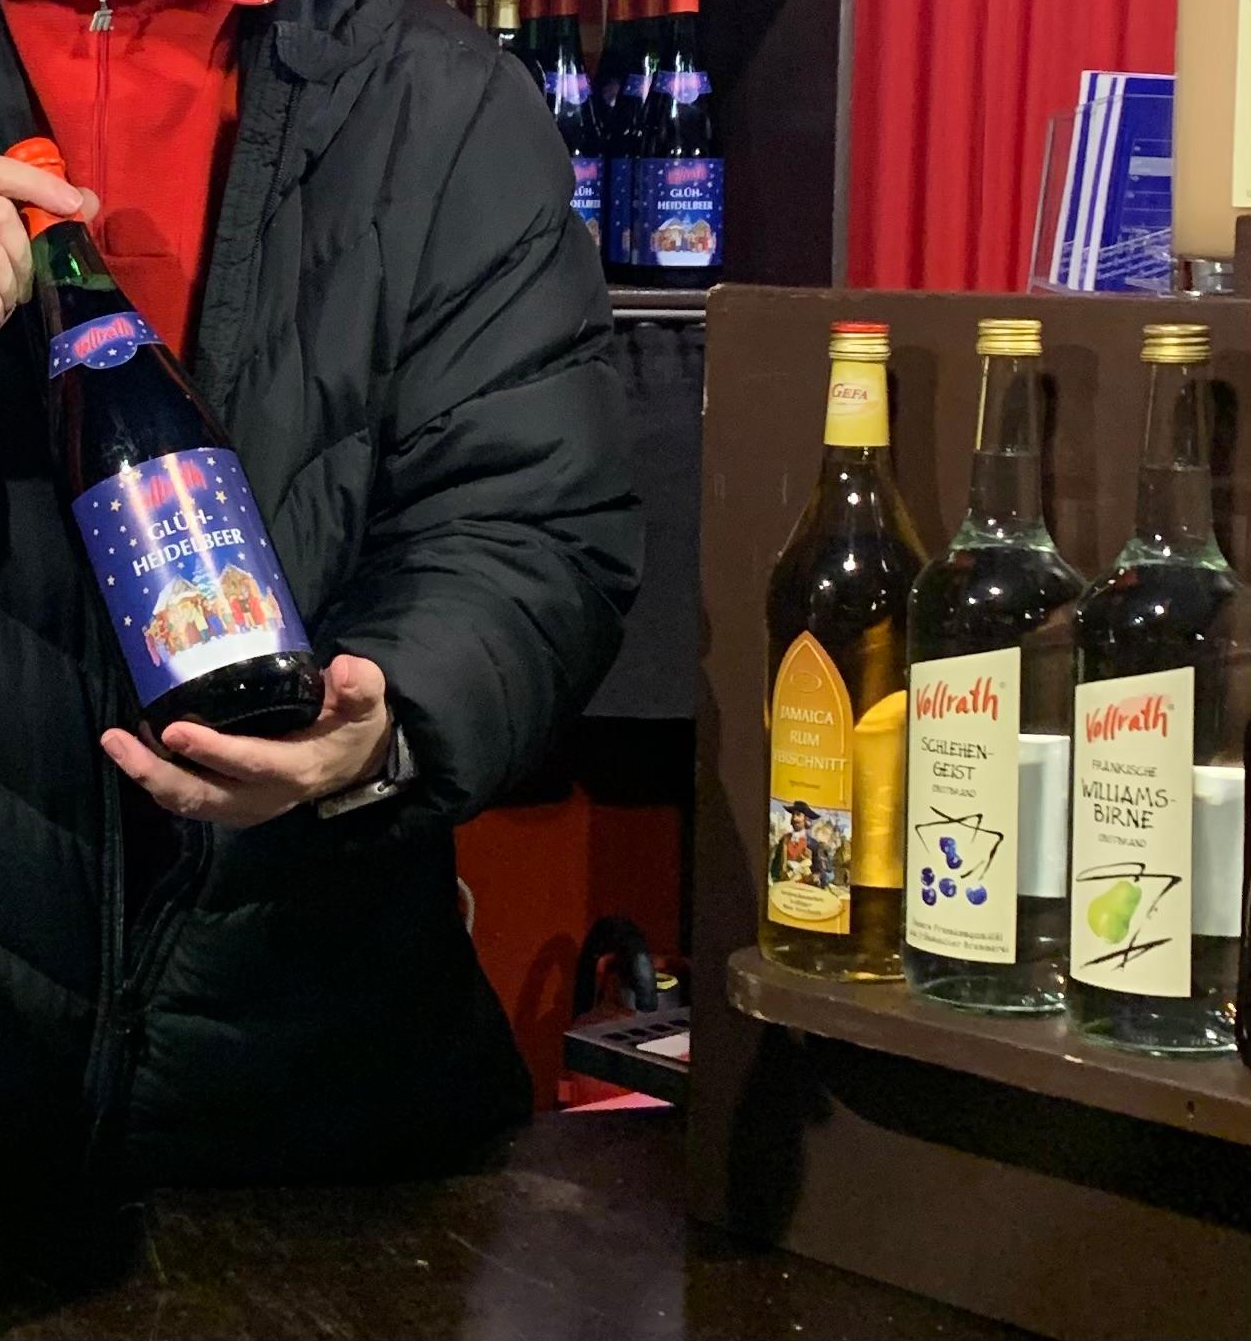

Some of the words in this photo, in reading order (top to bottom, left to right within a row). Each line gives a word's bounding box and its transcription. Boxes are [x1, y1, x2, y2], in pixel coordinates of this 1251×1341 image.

[669, 186, 703, 198] GLÜH-
[657, 200, 714, 210] HEIDELBEER
[132, 528, 245, 577] HEIDELBEER
[916, 677, 999, 721] Vollrath
[780, 705, 834, 725] JAMAICA
[1085, 695, 1168, 743] Vollrath
[790, 729, 820, 747] RUM
[921, 736, 995, 759] SCHLEHEN-
[933, 761, 976, 780] GEIST
[1081, 778, 1177, 809] WILLIAMS-
[1093, 803, 1154, 829] BIRNE
